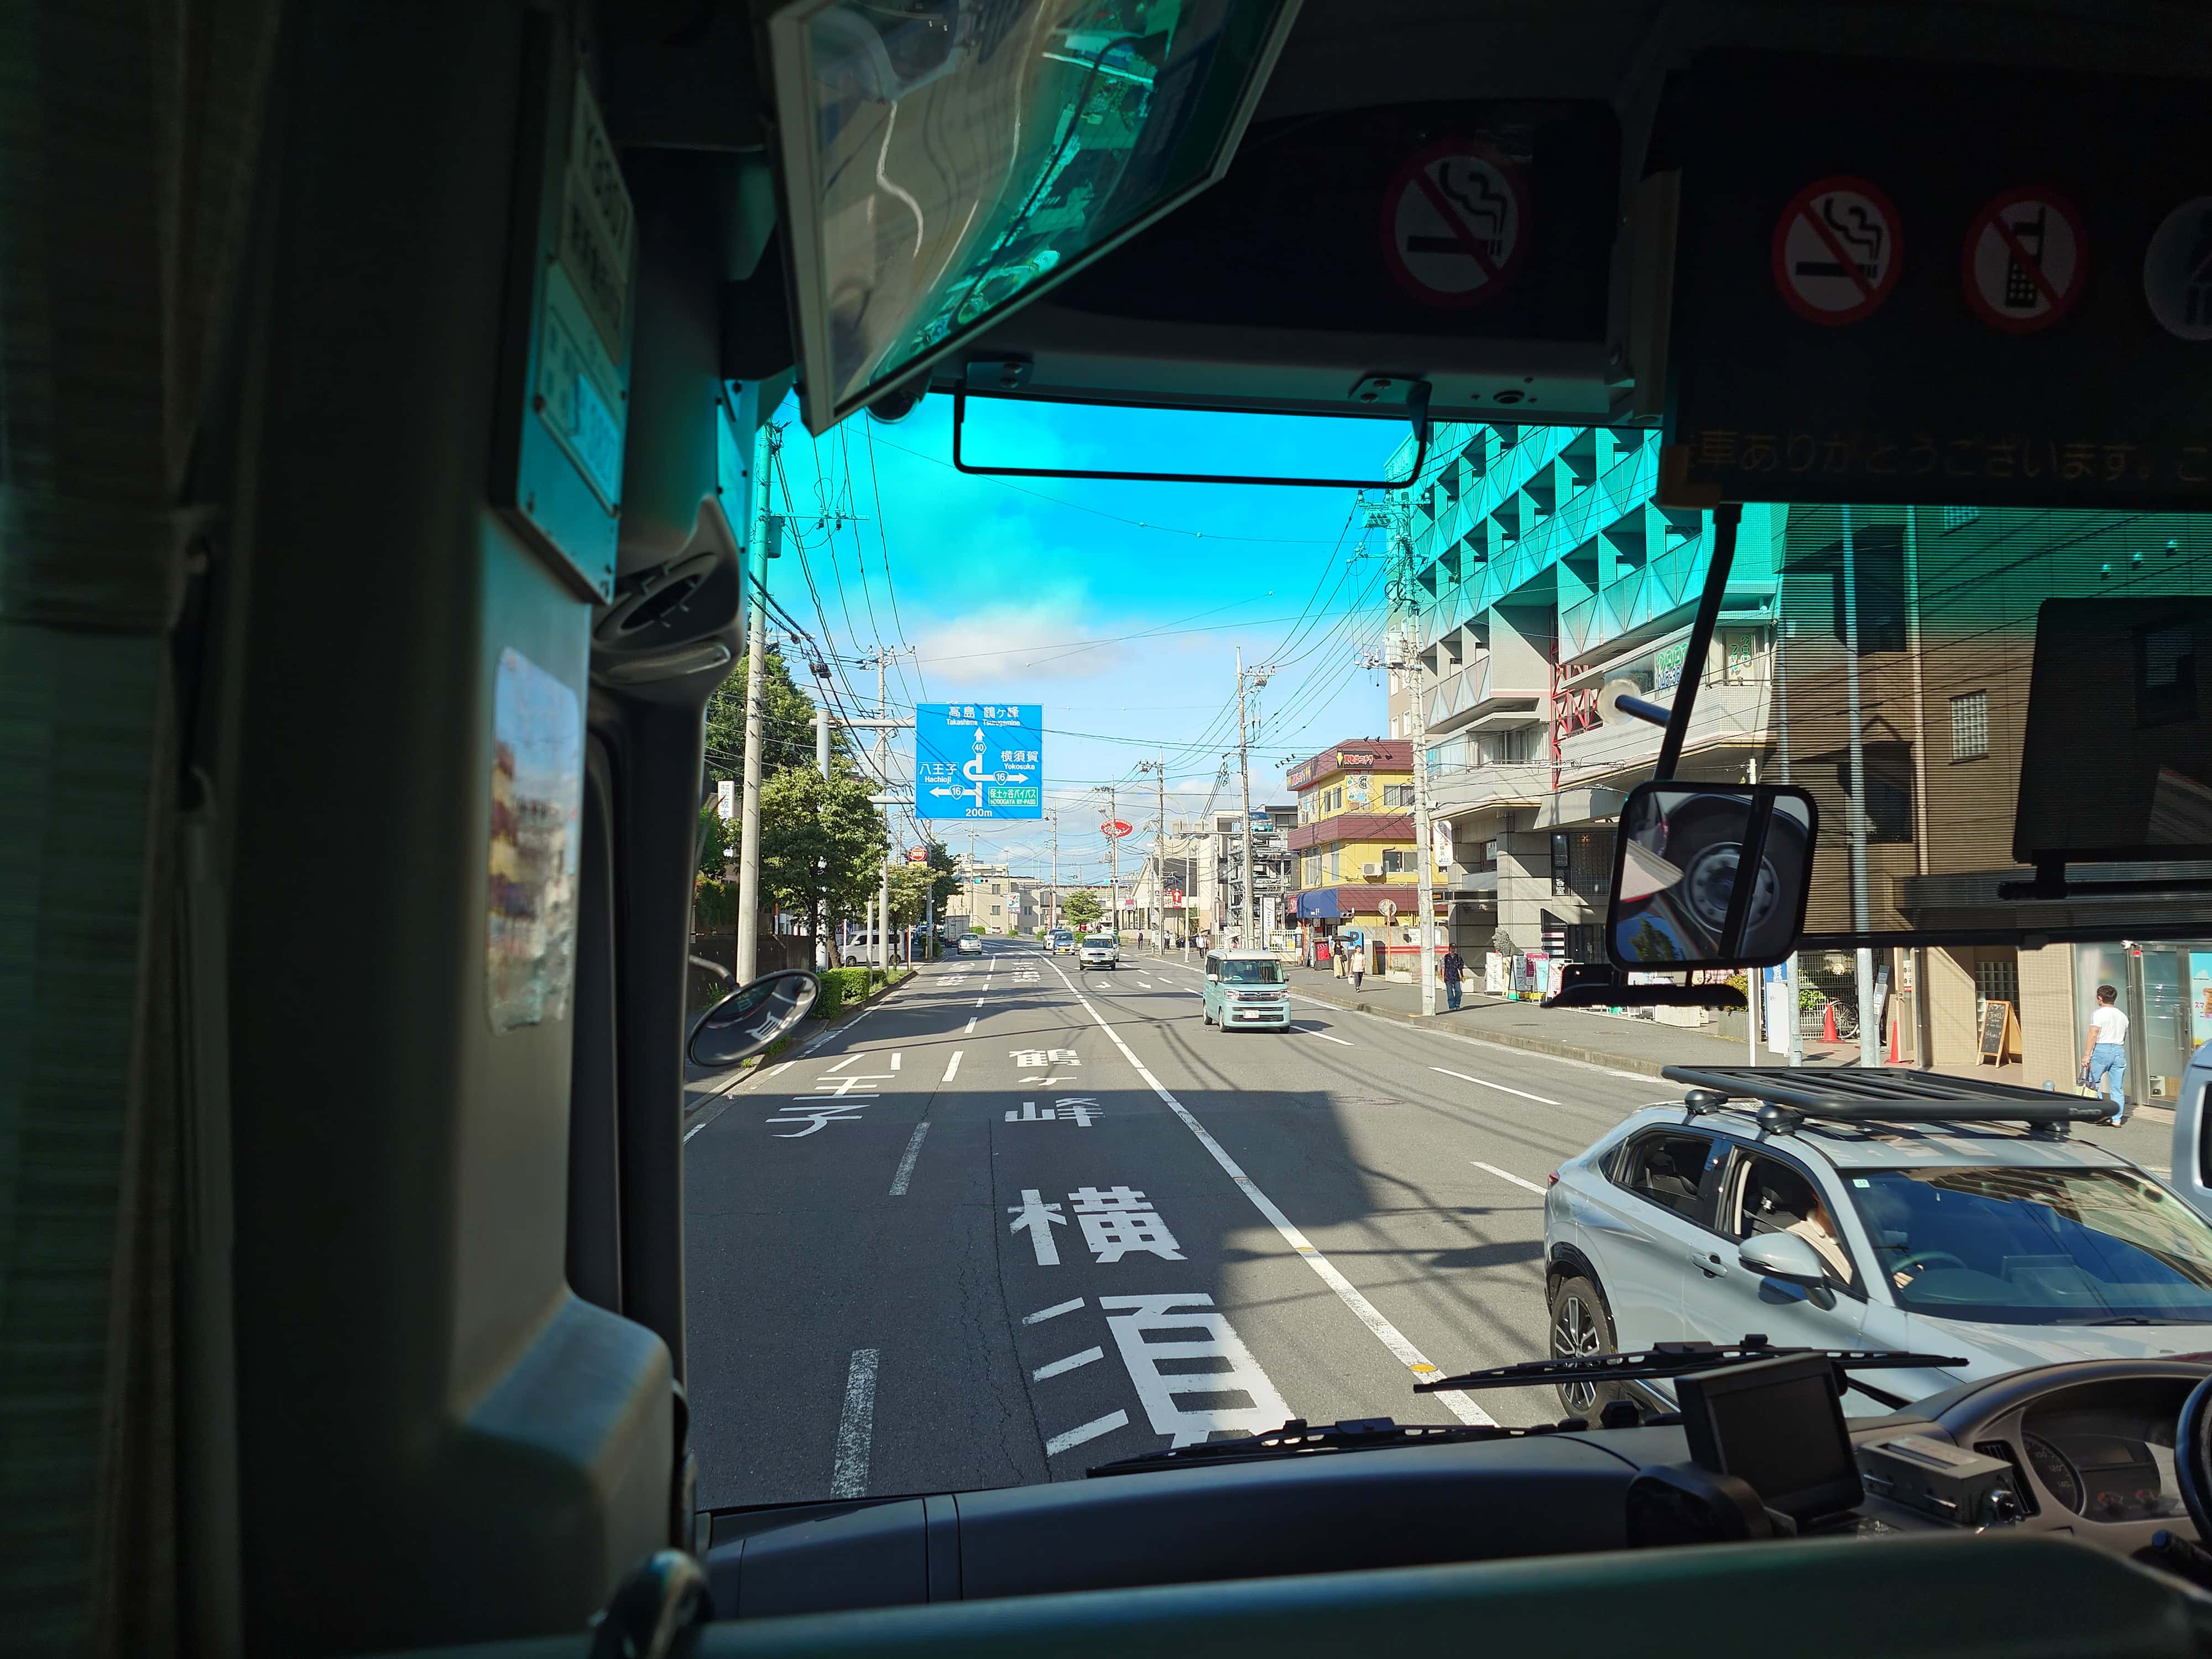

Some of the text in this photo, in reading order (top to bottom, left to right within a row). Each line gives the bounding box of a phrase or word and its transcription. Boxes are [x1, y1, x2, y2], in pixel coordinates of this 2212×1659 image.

[1657, 666, 1682, 689] 045-36
[948, 706, 975, 718] 高島
[1001, 750, 1039, 763] 横須賀
[919, 764, 957, 775] 八王子
[966, 808, 993, 817] 200m
